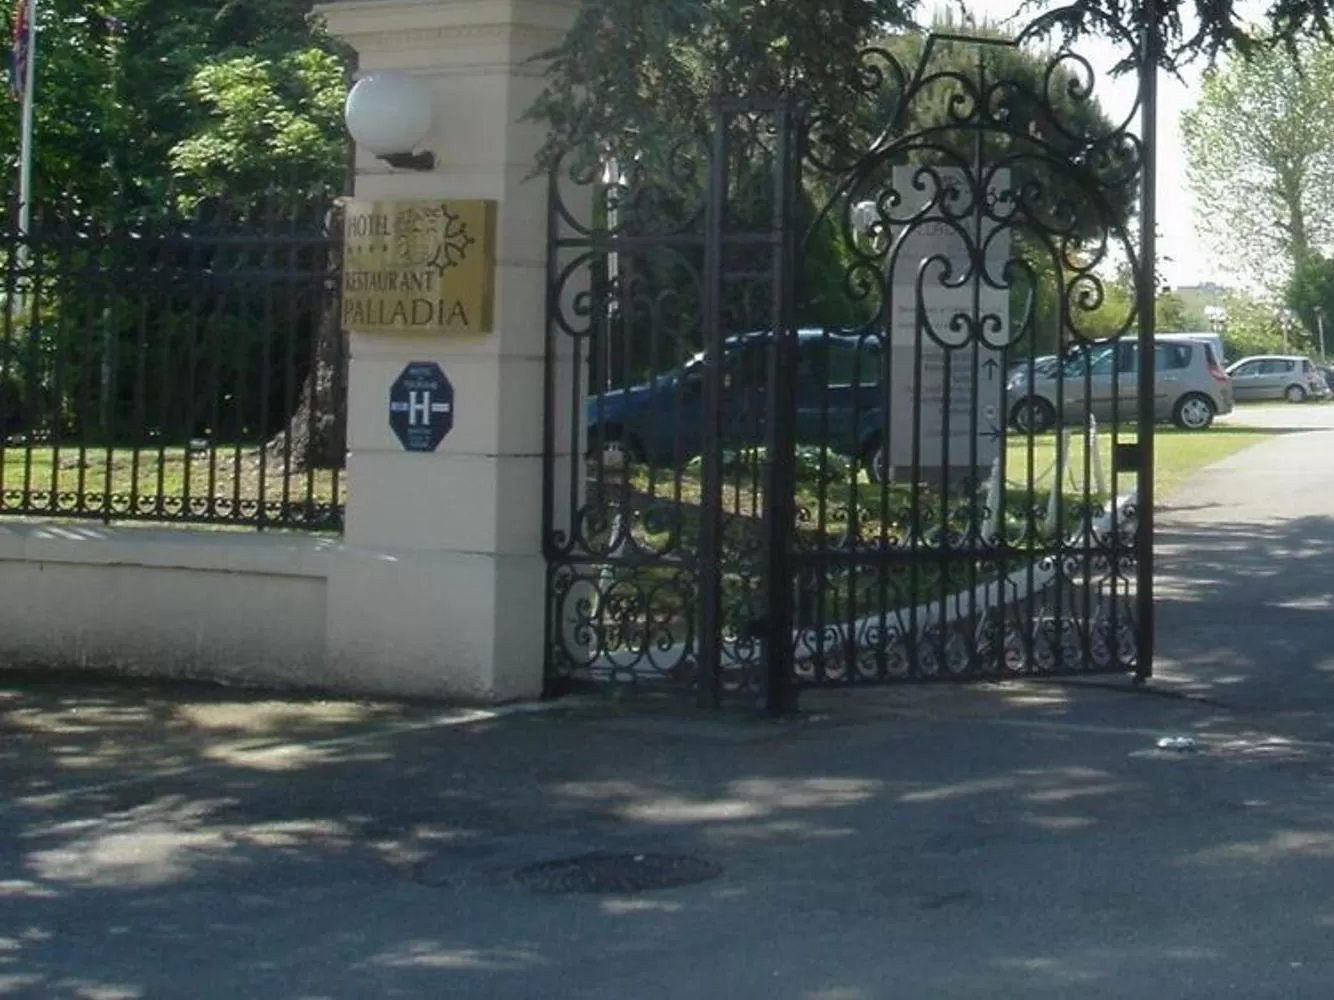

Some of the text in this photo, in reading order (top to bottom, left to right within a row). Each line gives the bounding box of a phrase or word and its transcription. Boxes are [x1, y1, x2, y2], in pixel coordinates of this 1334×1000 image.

[347, 213, 393, 238] HOTEL
[344, 269, 435, 293] RESTAURANT
[343, 298, 469, 327] PALLADIA
[409, 391, 431, 426] H
